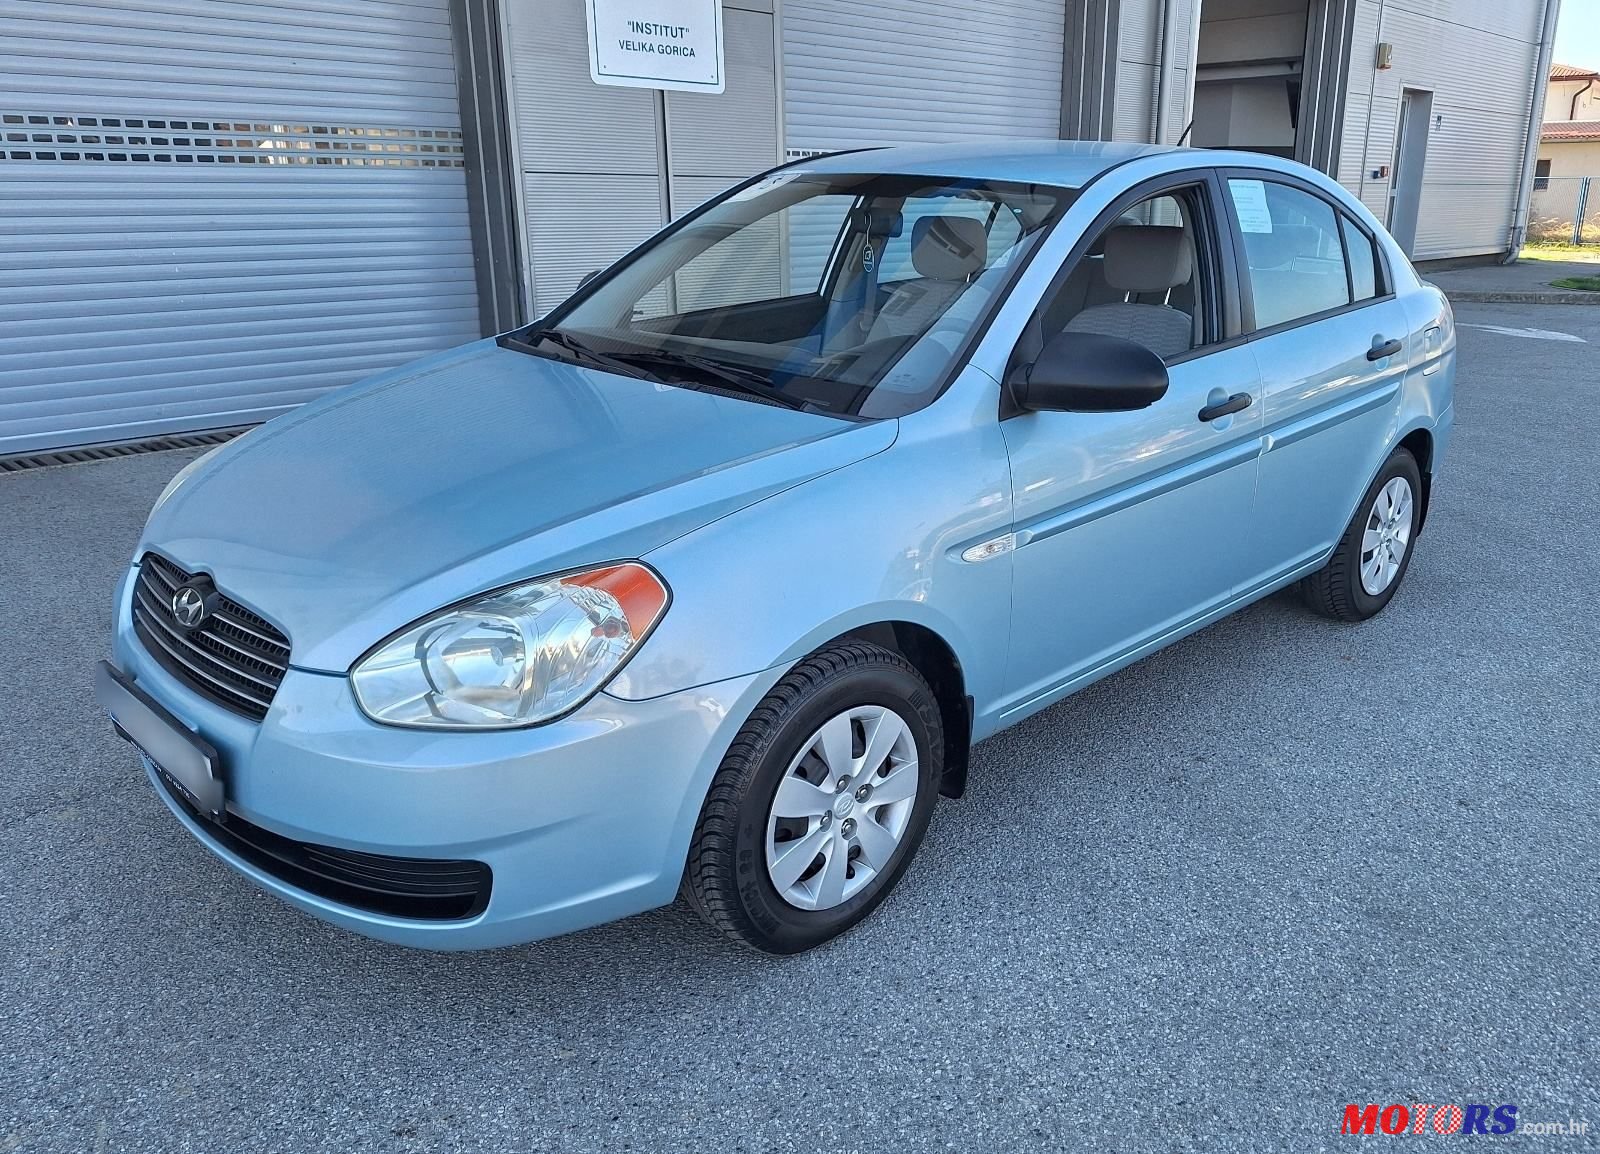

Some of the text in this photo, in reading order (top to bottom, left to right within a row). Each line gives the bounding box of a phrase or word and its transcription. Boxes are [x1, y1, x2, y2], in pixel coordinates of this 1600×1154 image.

[627, 20, 690, 39] "INSTITUT"
[618, 39, 696, 57] VELIKA GORICA
